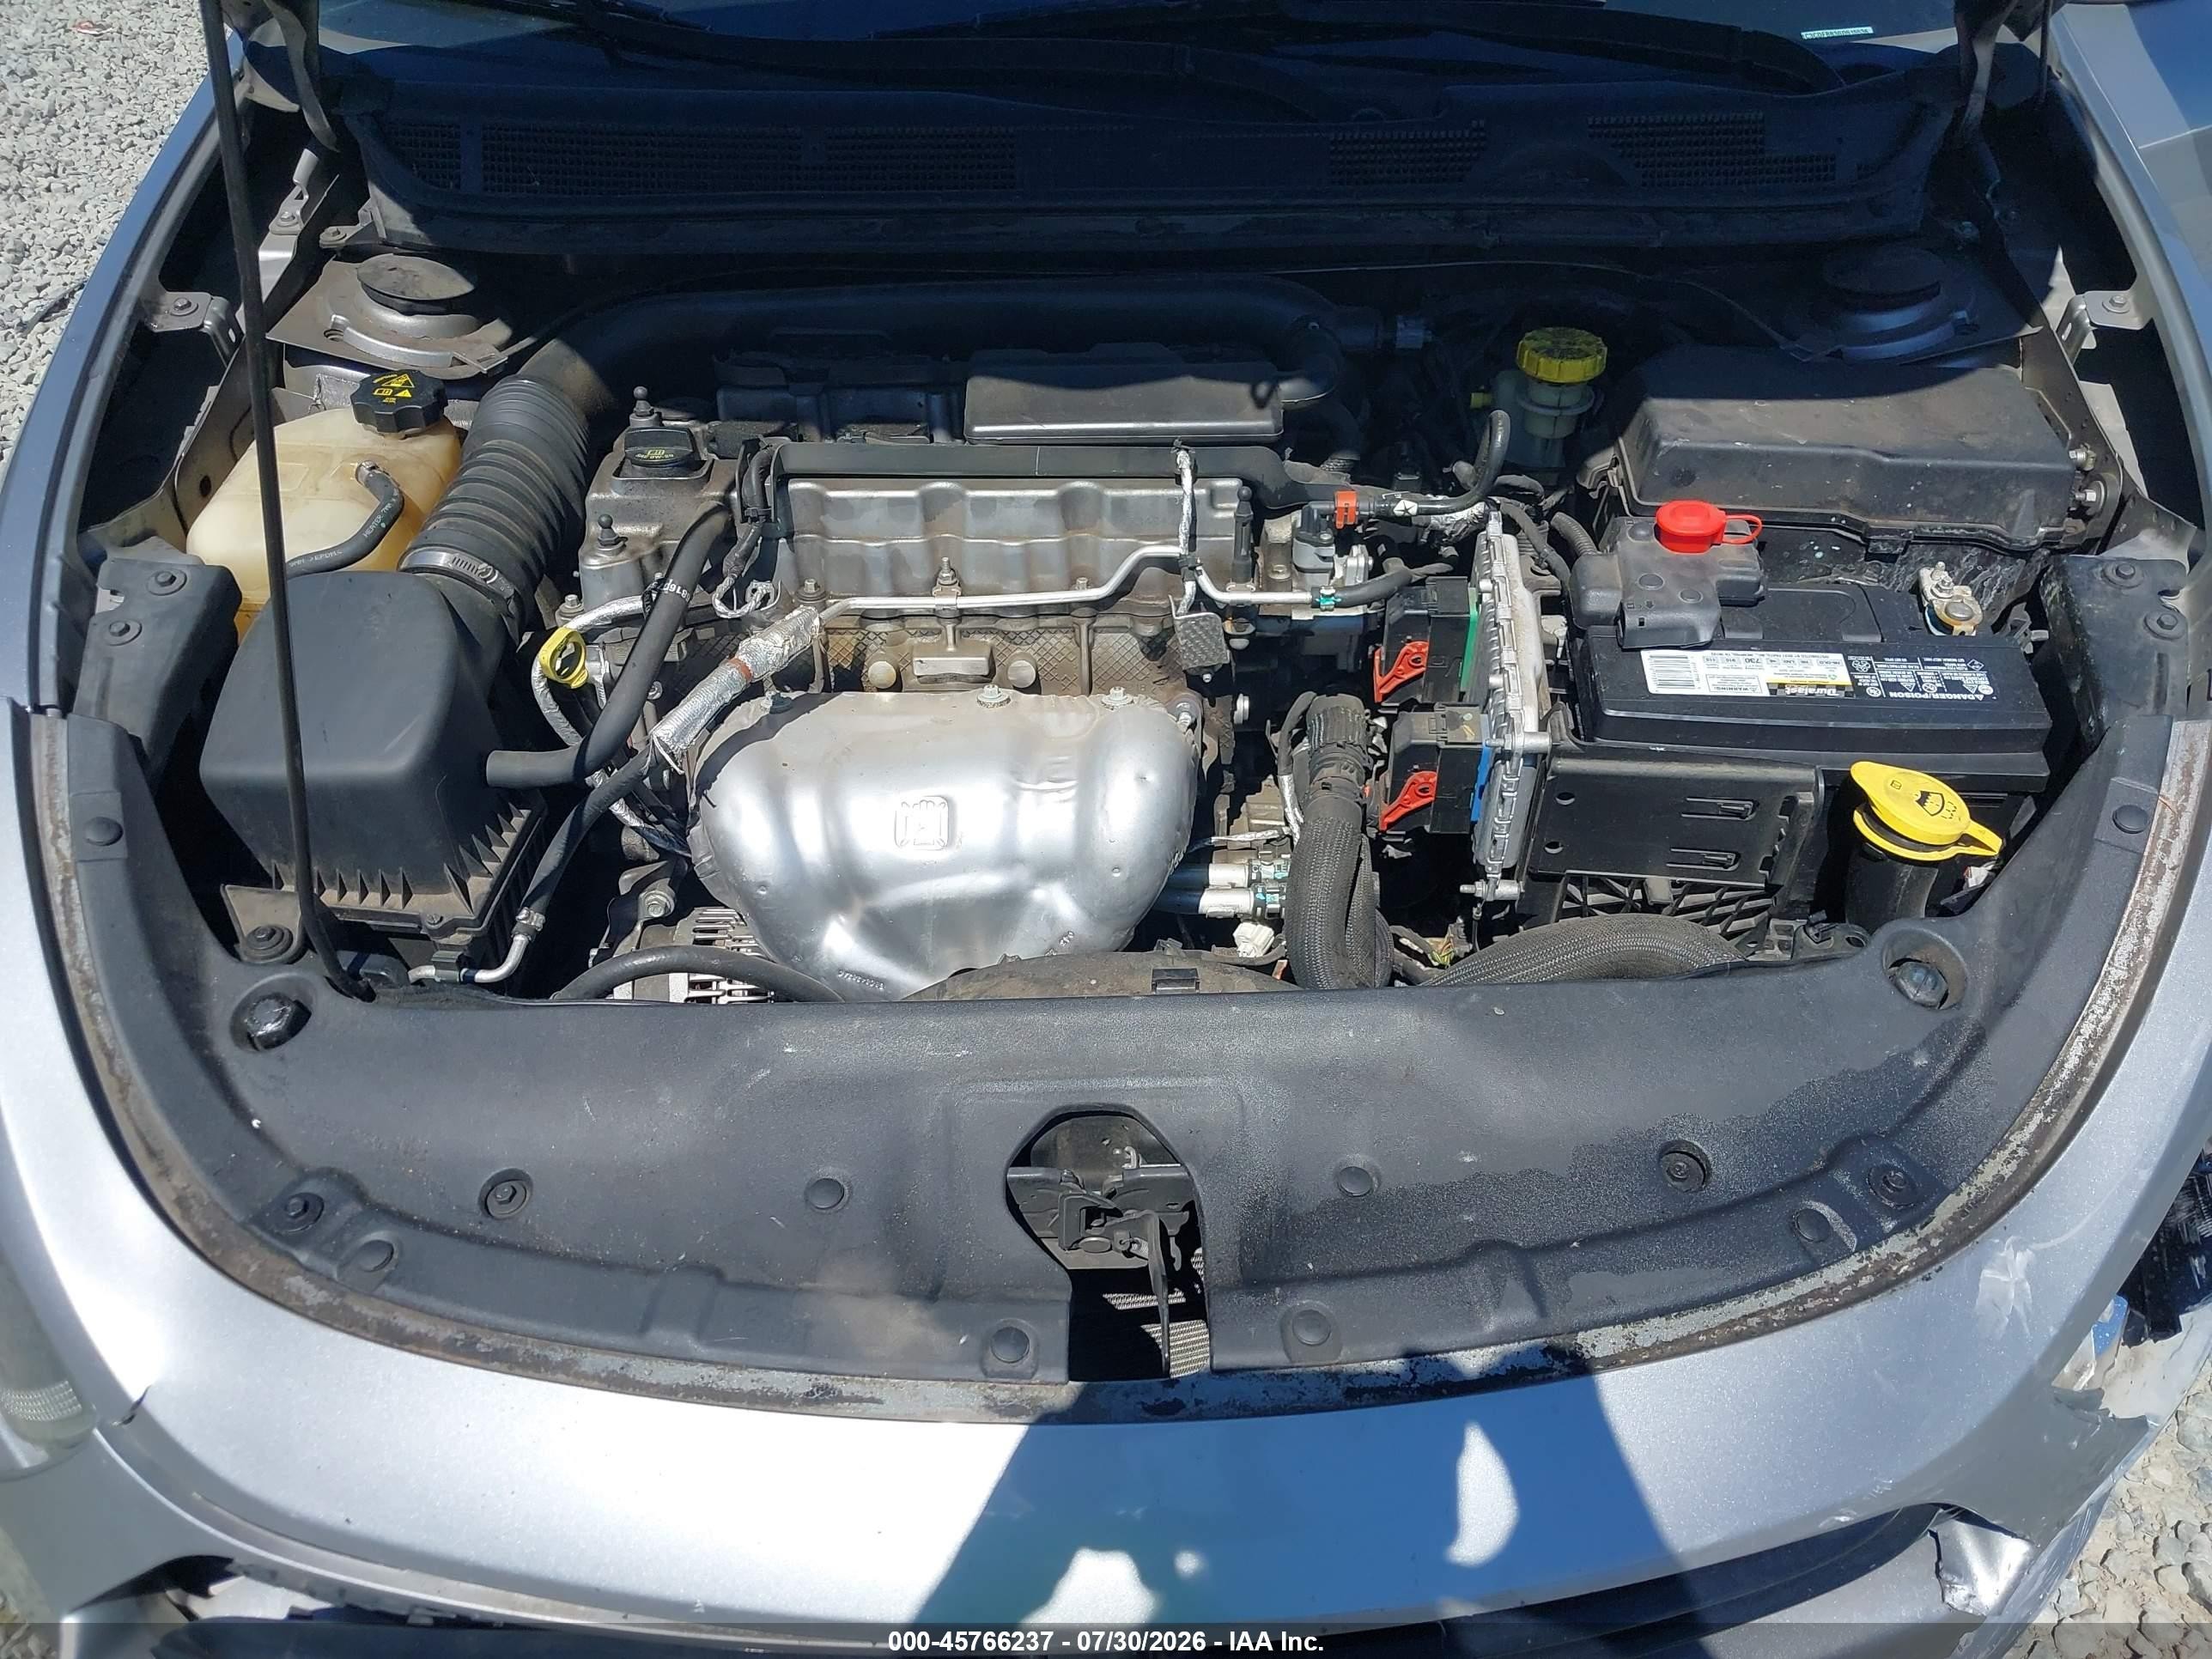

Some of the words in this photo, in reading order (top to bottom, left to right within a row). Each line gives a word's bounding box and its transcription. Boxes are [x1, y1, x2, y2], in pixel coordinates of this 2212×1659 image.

[362, 514, 384, 538] HEATER
[1785, 684, 1839, 696] Duralast
[1889, 691, 1976, 701] DANGER/POISON
